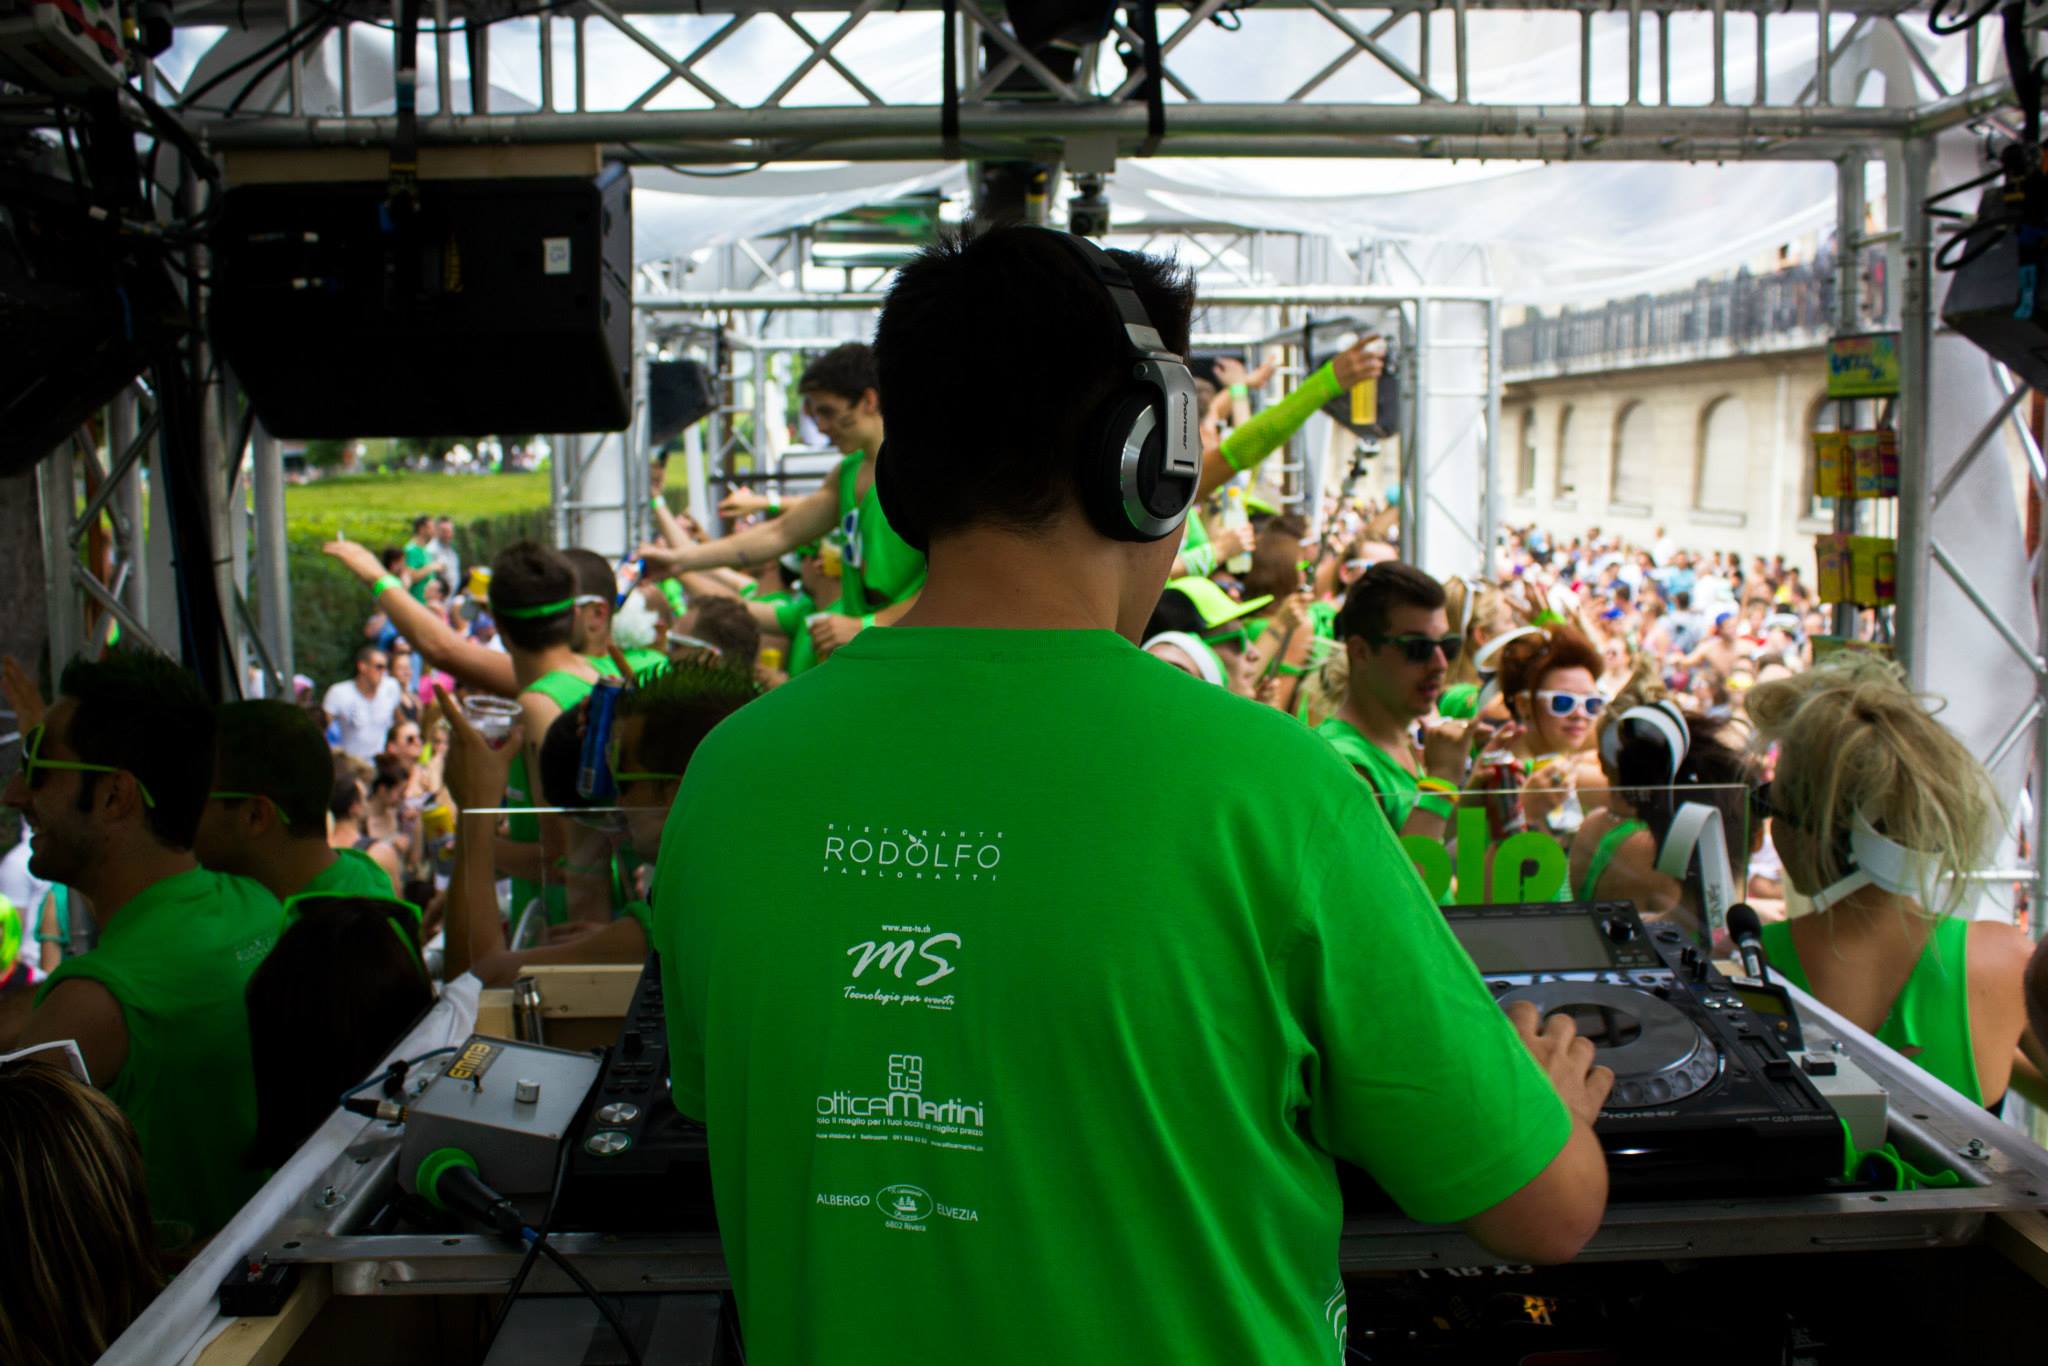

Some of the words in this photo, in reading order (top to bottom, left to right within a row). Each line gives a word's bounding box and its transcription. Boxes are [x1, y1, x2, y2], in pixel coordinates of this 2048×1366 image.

[827, 823, 1003, 838] RISTORANTE
[824, 836, 1001, 869] RODOLFO
[901, 994, 922, 1006] per
[838, 1116, 866, 1127] meglio
[867, 1118, 882, 1127] per
[903, 1119, 924, 1129] occhi
[931, 1123, 959, 1135] miglior
[816, 1193, 871, 1207] ALBERGO
[936, 1202, 979, 1222] ELVEZIA
